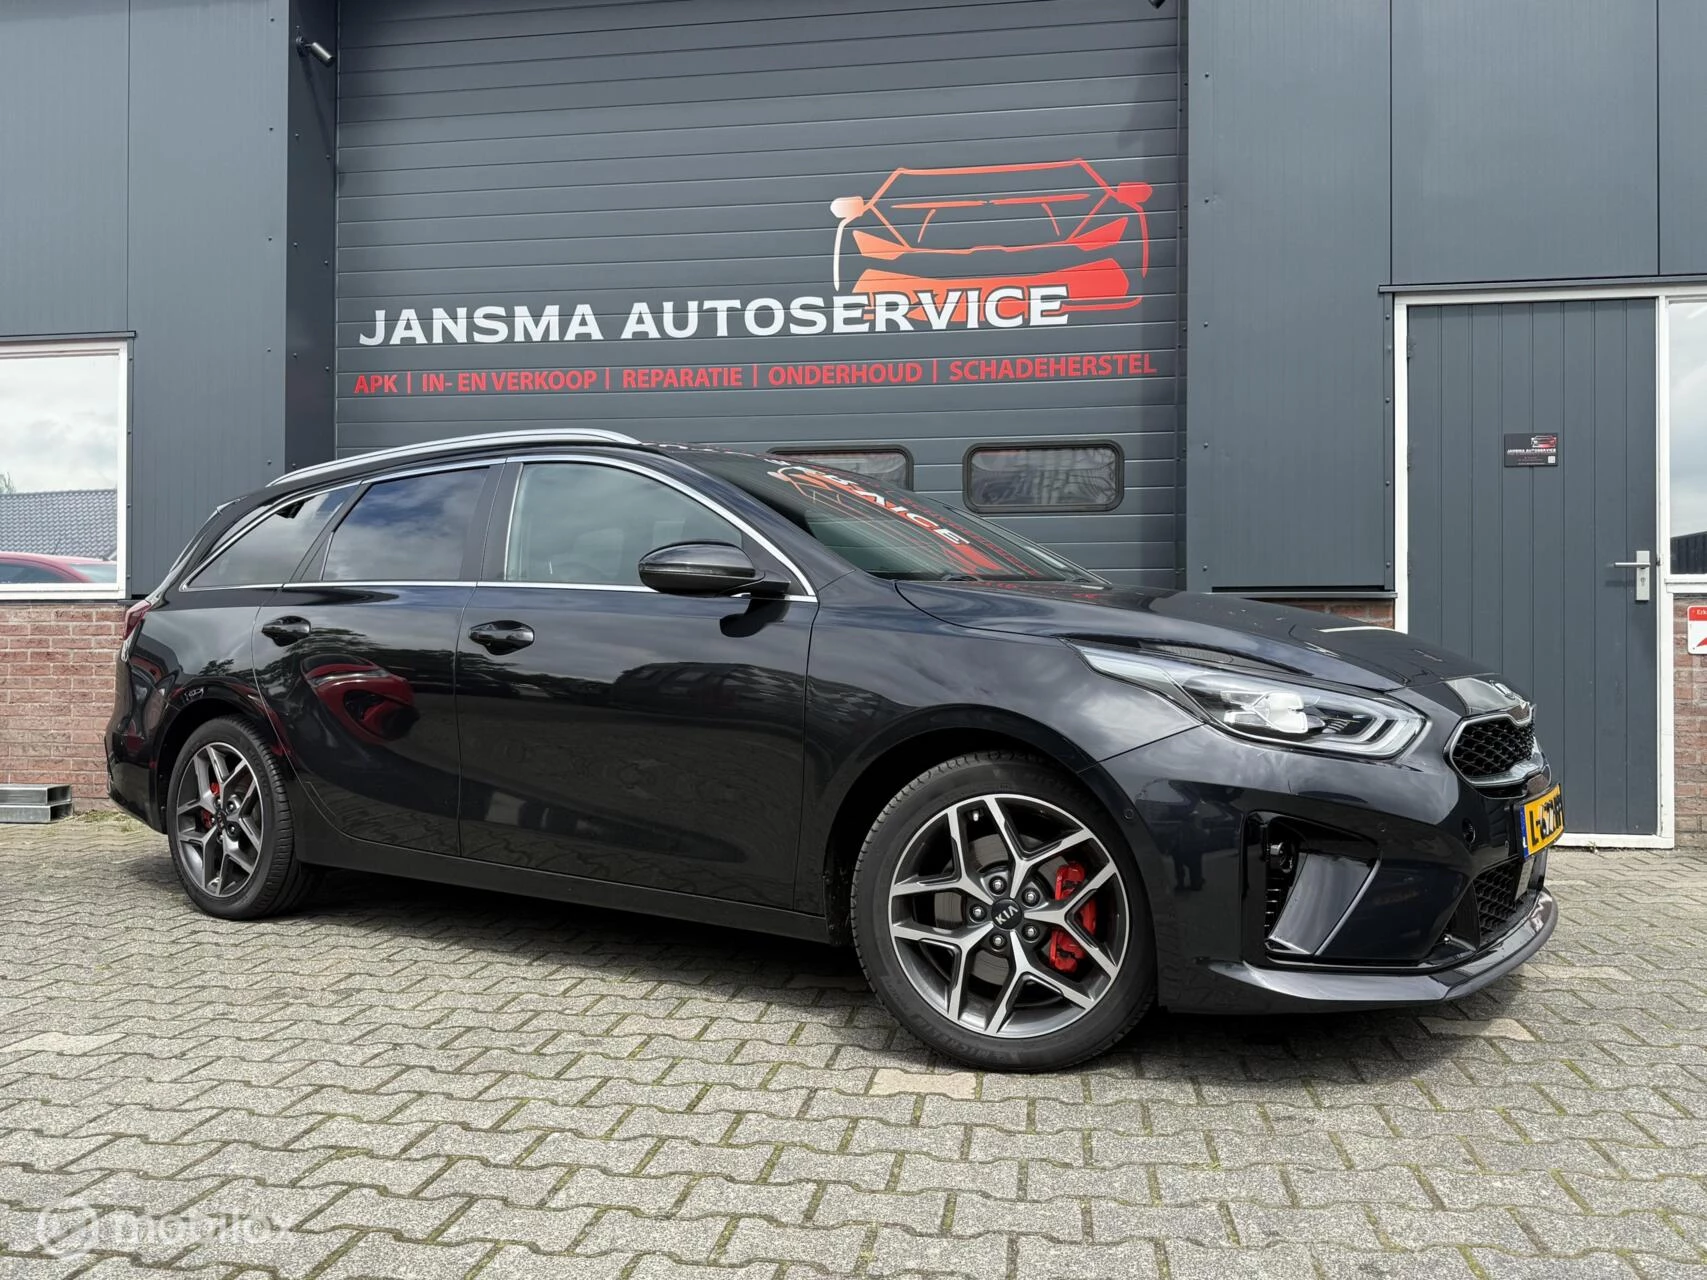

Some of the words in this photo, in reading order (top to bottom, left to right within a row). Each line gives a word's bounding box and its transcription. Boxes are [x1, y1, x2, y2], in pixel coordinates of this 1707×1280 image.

[359, 303, 604, 346] JANSMA
[620, 286, 1069, 340] AUTOSERVICE
[354, 373, 398, 394] APK
[421, 373, 453, 393] IN-
[457, 371, 488, 392] EN
[491, 369, 598, 391] VERKOOP
[622, 367, 743, 389] REPARATIE
[767, 362, 923, 387] ONDERHOUD
[949, 353, 1157, 382] SCHADEHERSTEL
[995, 905, 1019, 925] KIA
